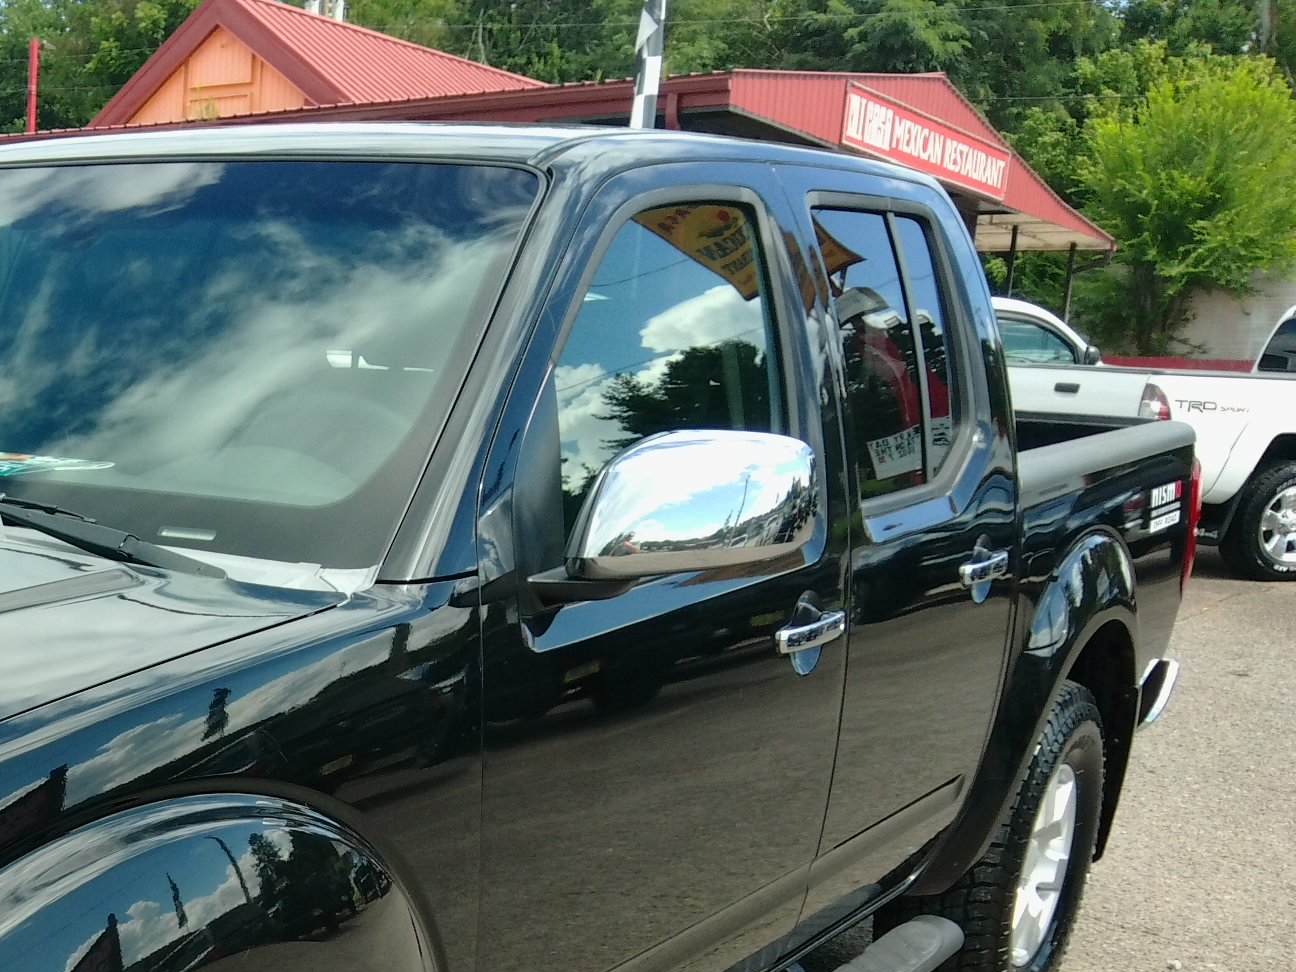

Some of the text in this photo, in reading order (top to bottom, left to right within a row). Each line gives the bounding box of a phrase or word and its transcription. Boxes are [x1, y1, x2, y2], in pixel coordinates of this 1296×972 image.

[892, 115, 945, 166] MEXICAN
[943, 137, 1006, 189] RESTAURANT
[1175, 399, 1217, 413] TRD
